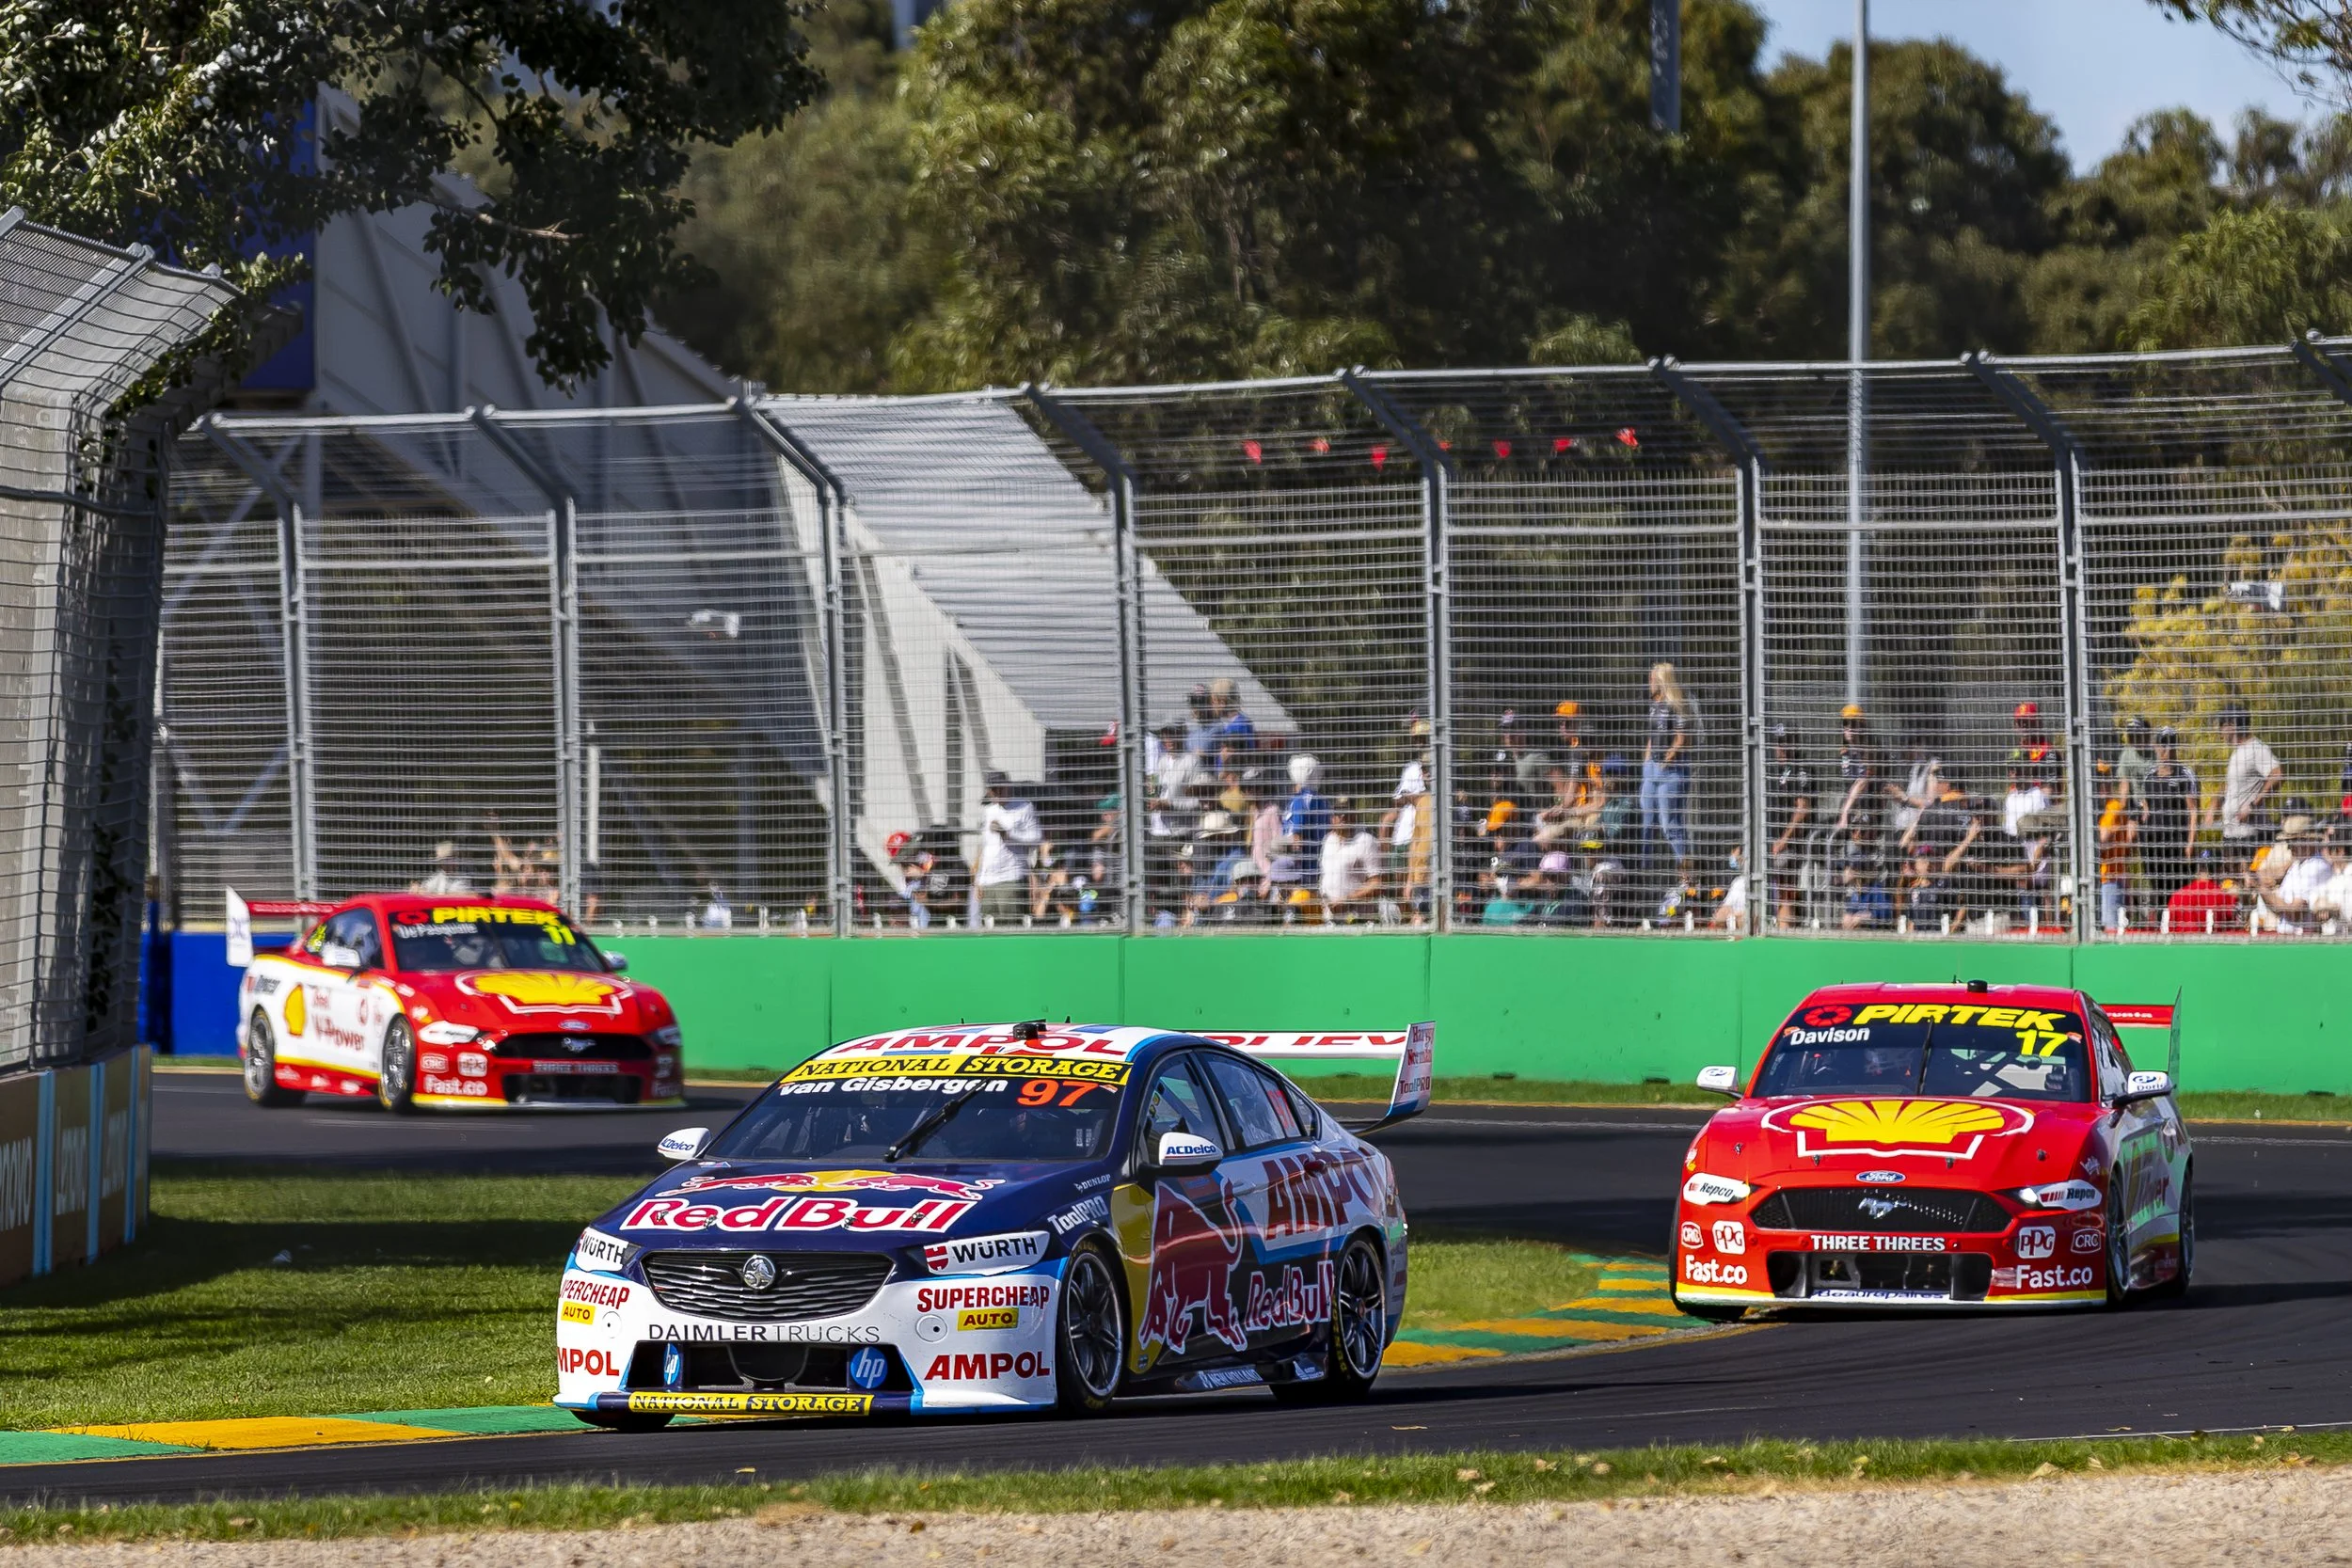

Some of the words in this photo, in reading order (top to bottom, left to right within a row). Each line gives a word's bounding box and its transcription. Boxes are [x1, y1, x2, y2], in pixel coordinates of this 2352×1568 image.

[433, 906, 562, 927] PIRTEK
[543, 925, 576, 945] 11
[1852, 1005, 2066, 1031] PIRTEK
[833, 1034, 1128, 1056] AMPOL
[1790, 1027, 1870, 1045] Davison
[2016, 1029, 2068, 1057] 17
[798, 1057, 951, 1078] NATIONAL
[963, 1056, 1123, 1079] STORAGE
[780, 1081, 832, 1097] van
[840, 1077, 1009, 1095] Gisbergen
[1016, 1079, 1100, 1108] 97
[1166, 1144, 1216, 1155] ACDelco
[1081, 1174, 1111, 1190] DUNLOP
[1700, 1182, 1734, 1197] Repco
[2067, 1188, 2096, 1201] Repco
[621, 1196, 798, 1231] Red
[774, 1197, 981, 1232] Bull
[1047, 1196, 1109, 1235] ToolPRO
[1810, 1235, 1870, 1250] THREE
[1873, 1236, 1946, 1252] THREES
[2074, 1234, 2099, 1248] CRC
[1685, 1255, 1748, 1285] Fast.co
[2016, 1265, 2093, 1289] Fast.co
[917, 1285, 1050, 1313] SUPERCHEAP
[1246, 1265, 1290, 1331] Red
[563, 1306, 591, 1320] AUTO
[963, 1313, 1013, 1326] AUTO
[648, 1323, 767, 1341] DAIMLER
[769, 1324, 881, 1343] TRUCKS
[557, 1347, 620, 1376] MPOL
[856, 1348, 885, 1389] hp
[924, 1352, 1051, 1380] AMPOL
[633, 1395, 740, 1410] NATIONAL
[751, 1395, 861, 1412] STORAGE
